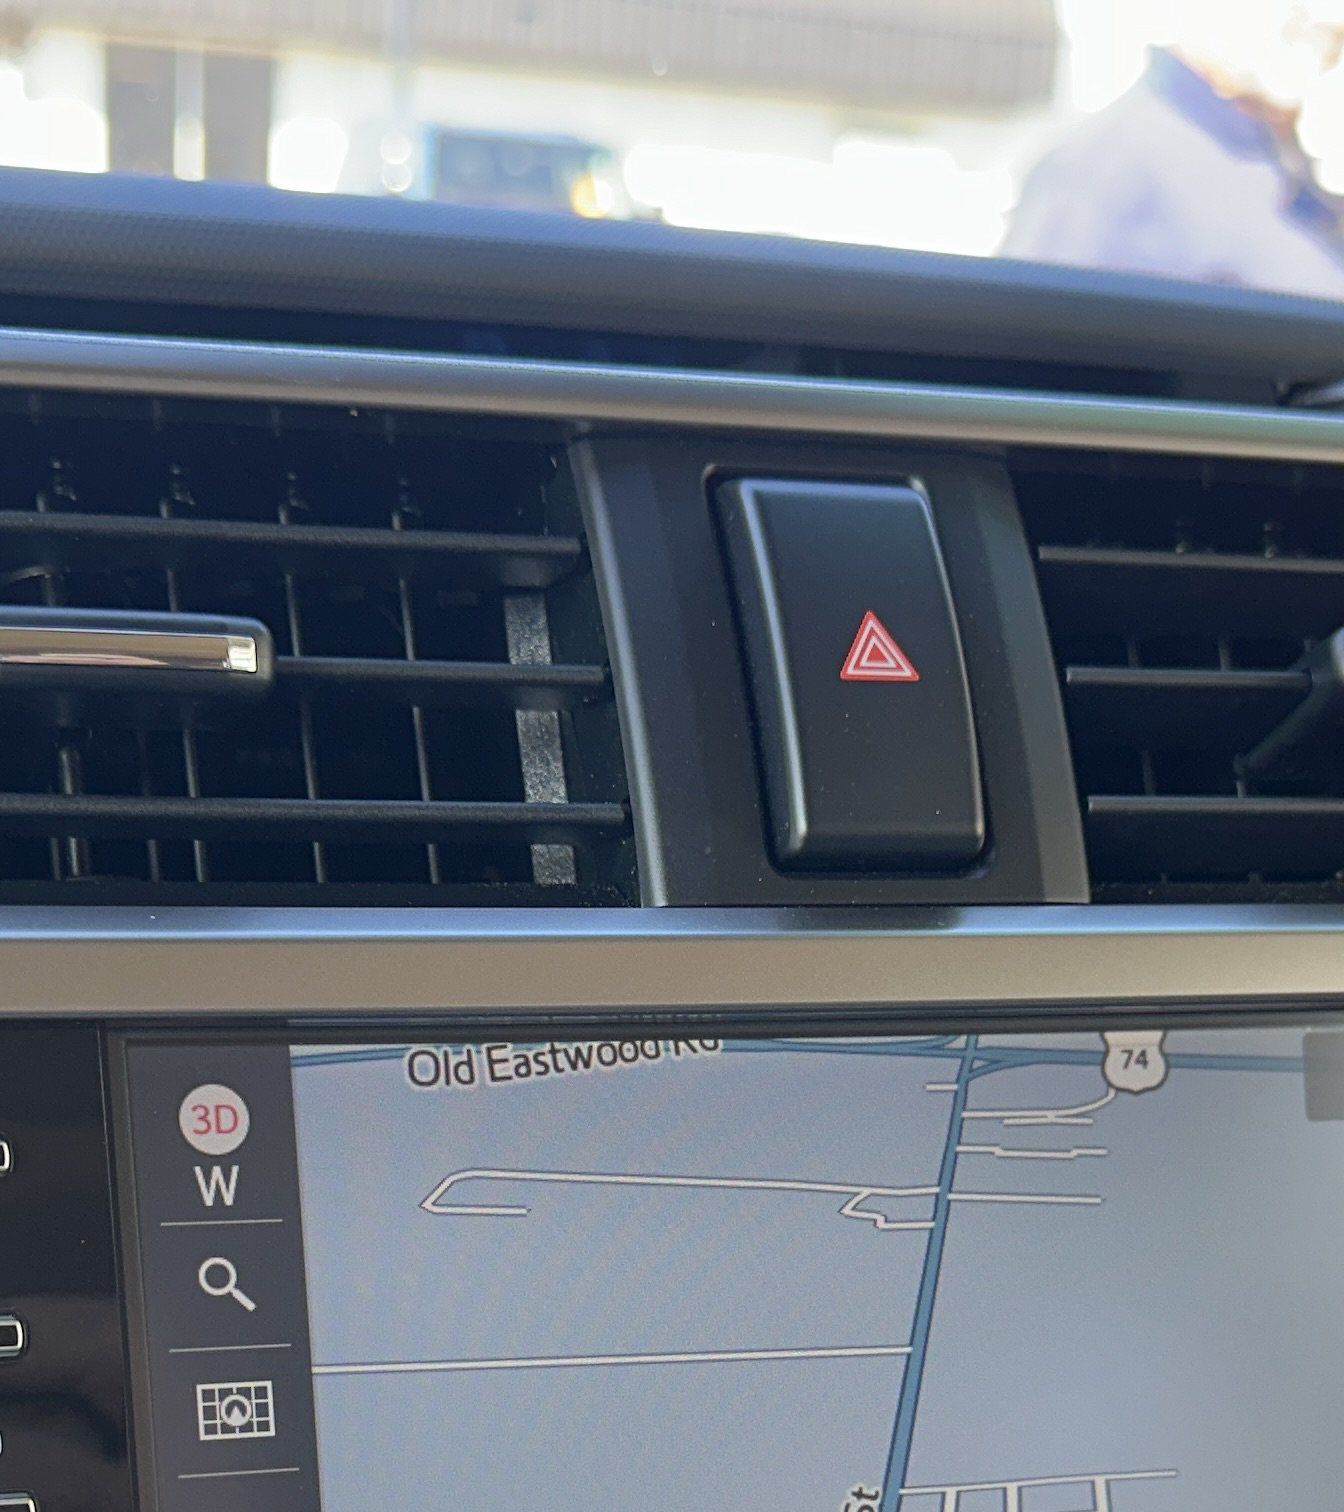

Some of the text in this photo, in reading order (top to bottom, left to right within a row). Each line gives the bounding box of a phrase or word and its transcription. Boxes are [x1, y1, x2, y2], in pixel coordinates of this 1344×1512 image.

[407, 1048, 476, 1087] Old
[1121, 1049, 1150, 1071] 74
[190, 1103, 239, 1136] 3D
[194, 1165, 239, 1207] W
